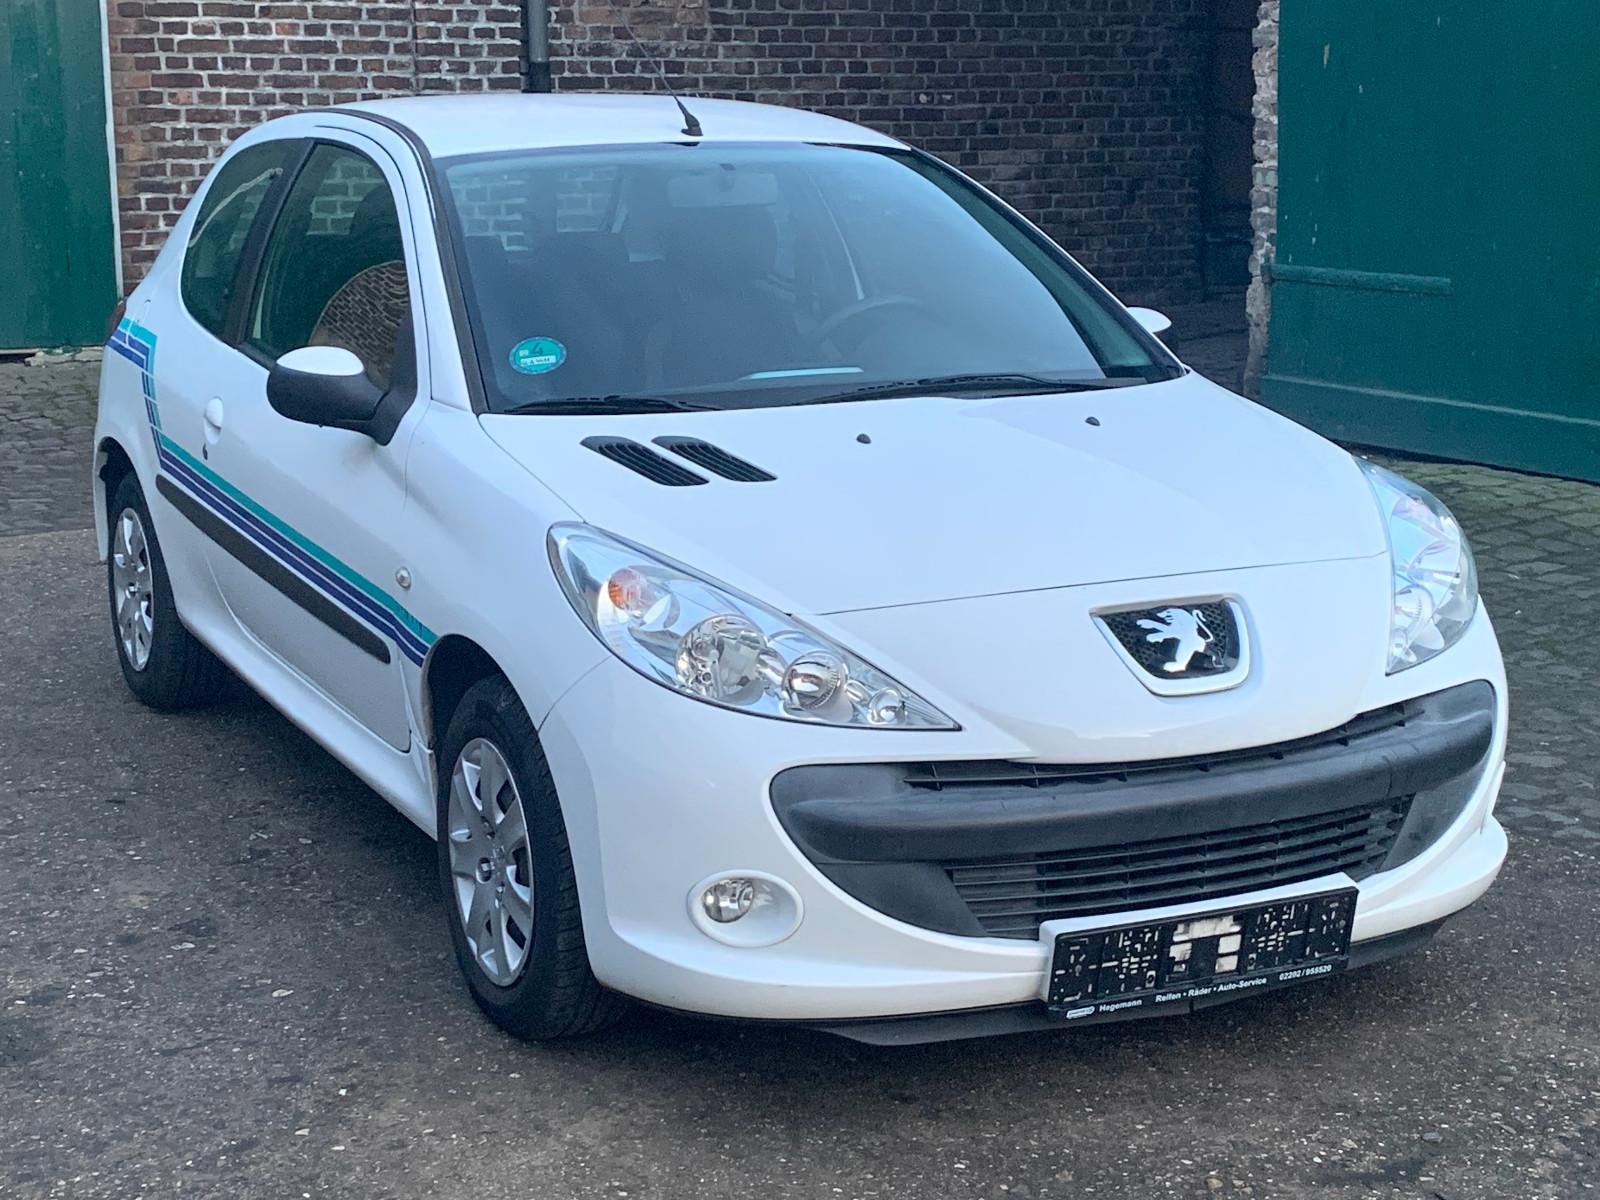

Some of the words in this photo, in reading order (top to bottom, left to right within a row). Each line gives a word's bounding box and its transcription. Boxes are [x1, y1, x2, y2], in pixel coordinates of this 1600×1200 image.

[531, 341, 544, 356] 4
[1155, 992, 1182, 1003] Reifen
[1187, 987, 1213, 997] Räder
[1217, 977, 1268, 992] Auto-Service
